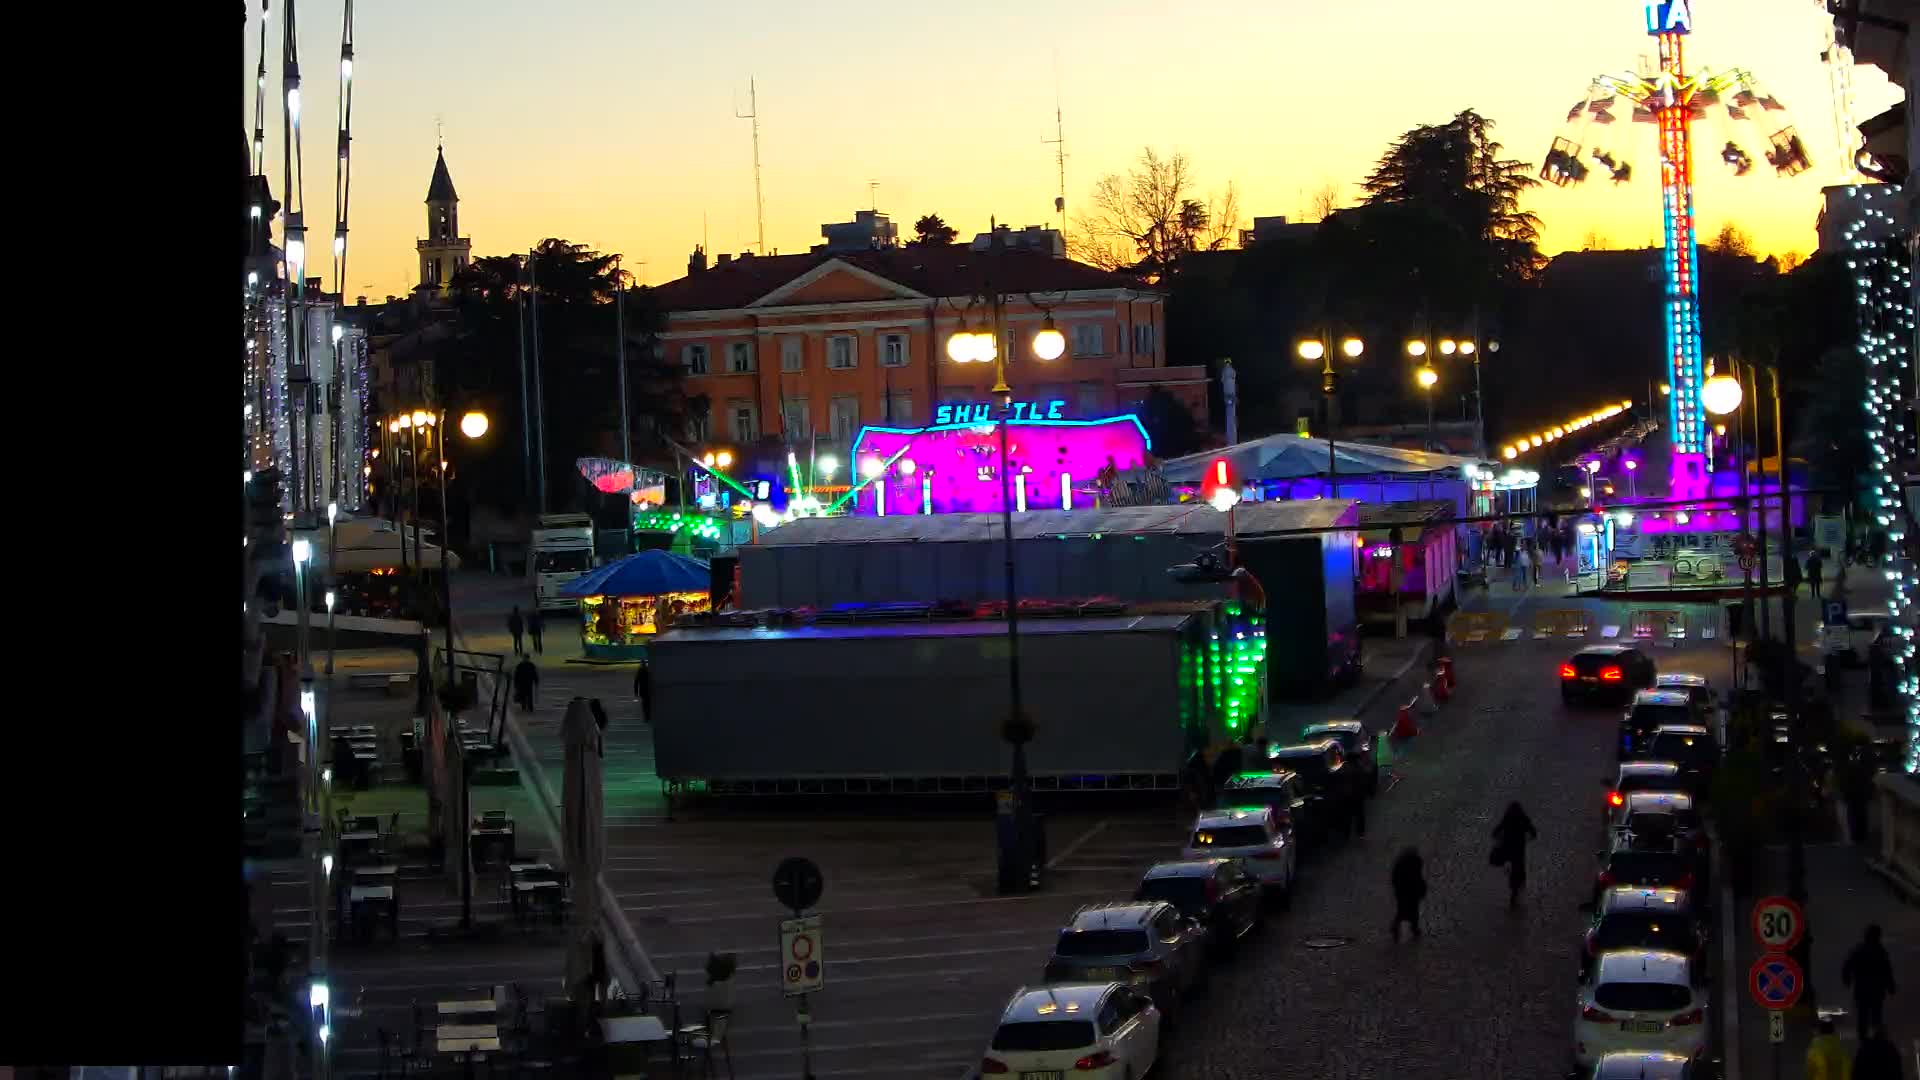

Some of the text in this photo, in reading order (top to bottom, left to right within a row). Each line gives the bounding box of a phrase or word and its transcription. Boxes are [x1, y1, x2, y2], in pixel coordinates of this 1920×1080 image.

[935, 399, 1065, 424] SHUTLE
[1828, 603, 1841, 623] P
[1763, 912, 1791, 938] 30
